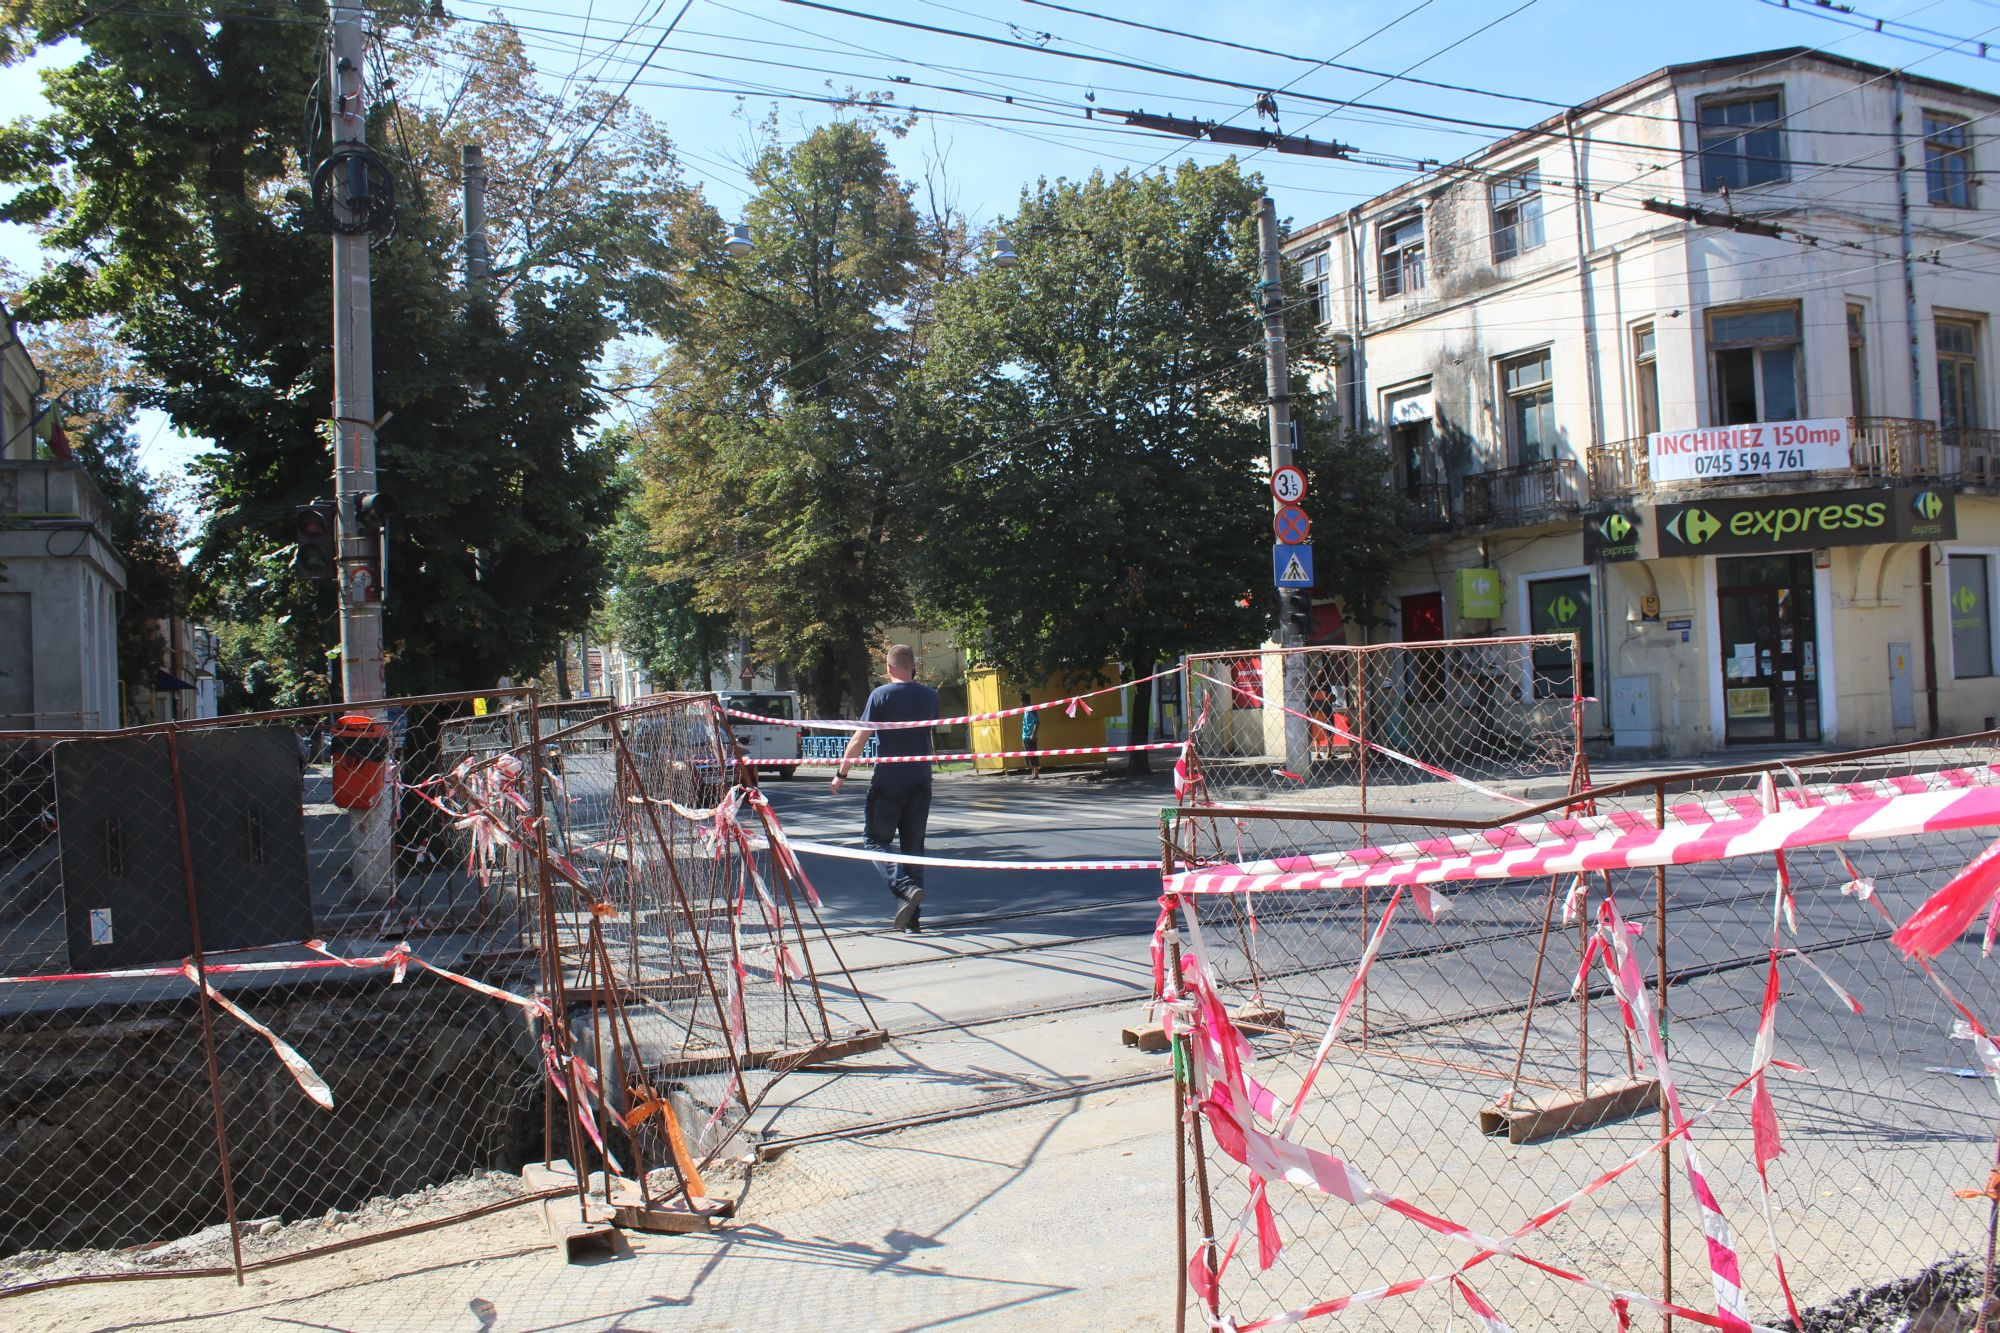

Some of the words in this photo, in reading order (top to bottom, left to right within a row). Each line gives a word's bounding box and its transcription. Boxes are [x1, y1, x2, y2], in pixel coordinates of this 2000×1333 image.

[1773, 425, 1840, 446] 150mp
[1695, 454, 1732, 474] 0745
[1739, 451, 1772, 472] 594
[1778, 448, 1804, 469] 761
[1731, 503, 1886, 540] express
[1911, 524, 1943, 536] express
[1602, 545, 1638, 557] express
